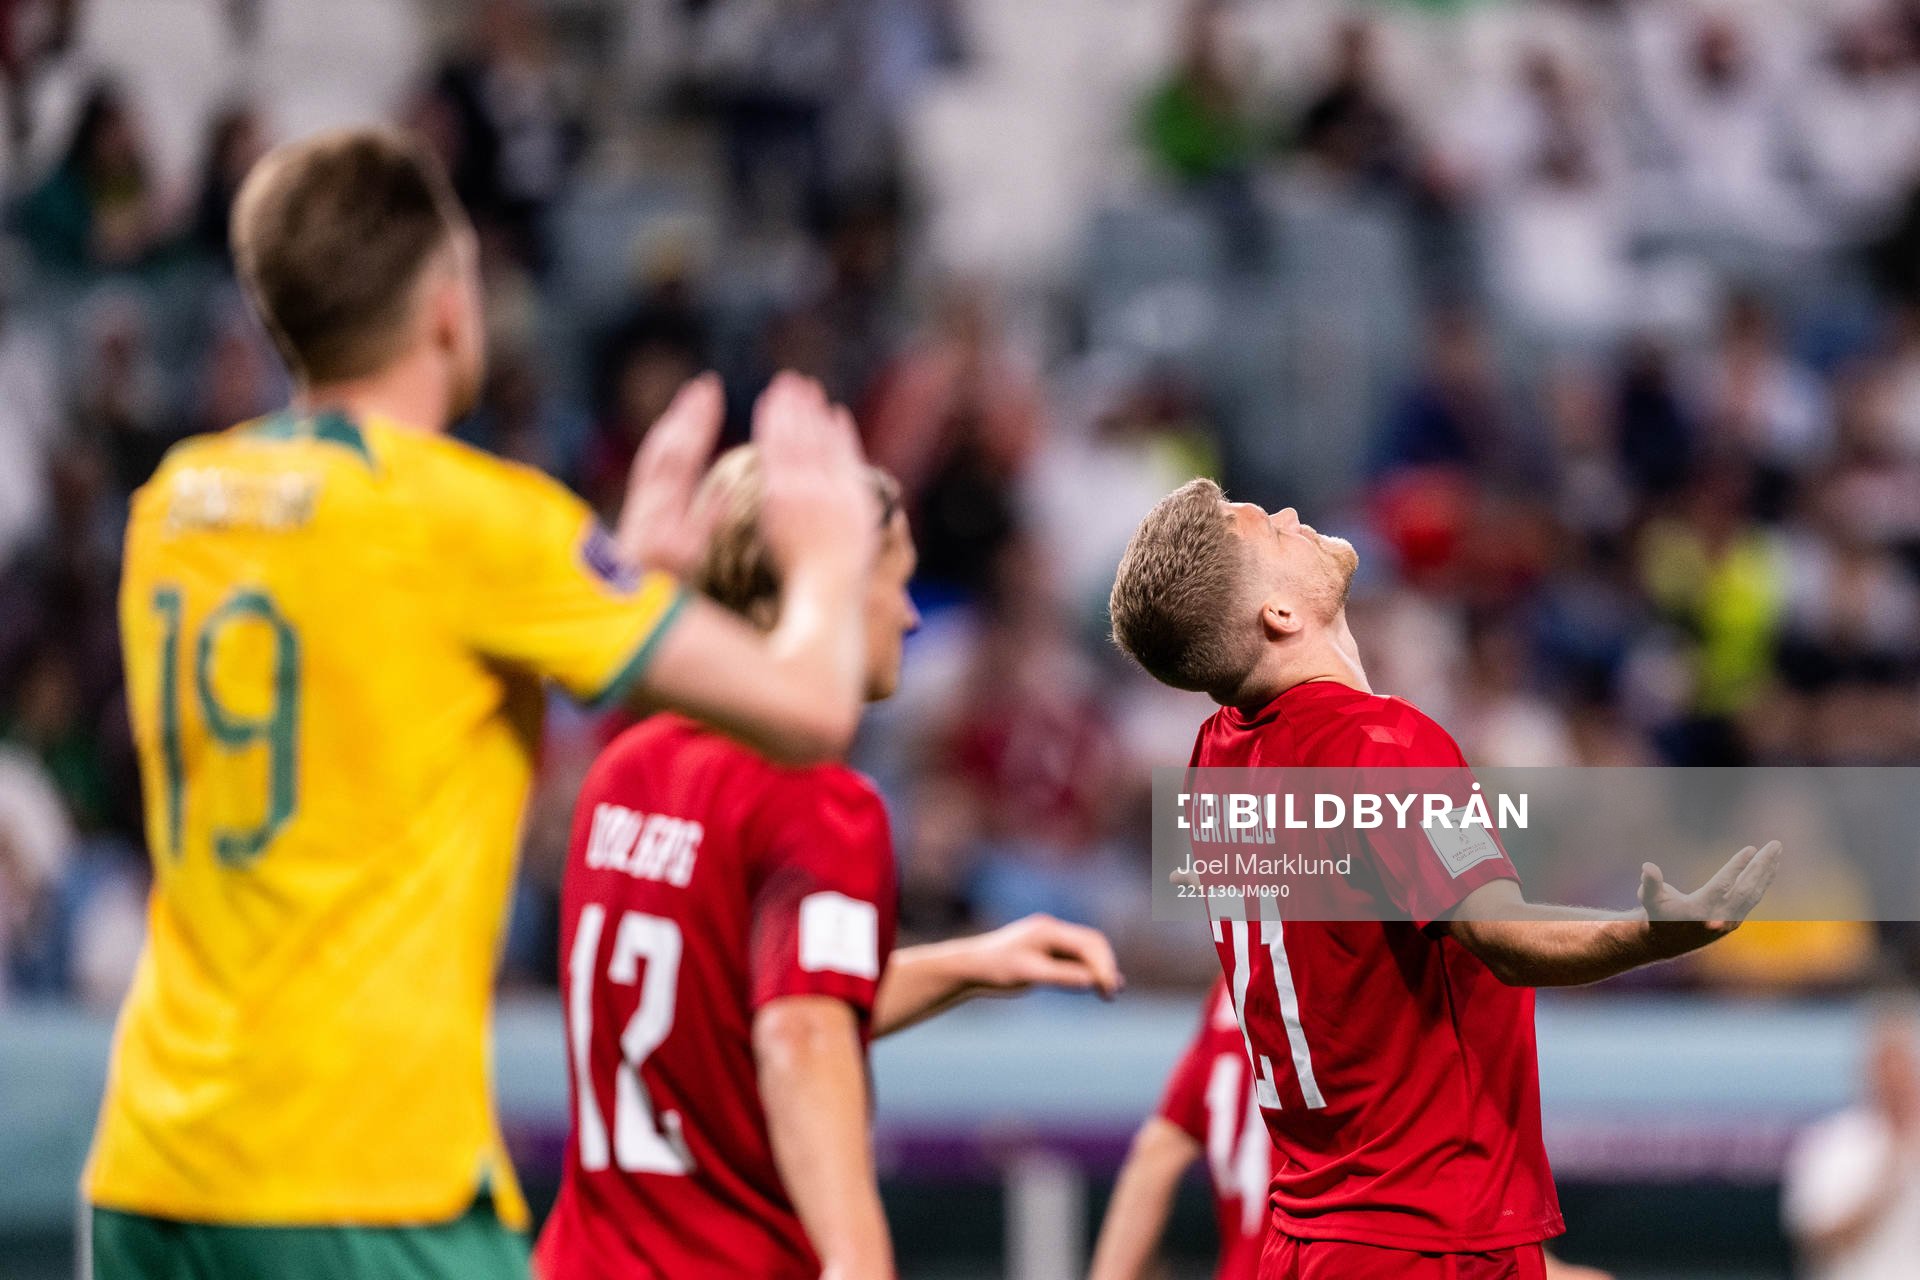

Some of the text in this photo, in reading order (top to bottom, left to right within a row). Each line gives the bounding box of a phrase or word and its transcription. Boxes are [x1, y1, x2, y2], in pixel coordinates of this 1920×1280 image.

[151, 585, 301, 866] 19
[1191, 792, 1276, 845] CORNEIUS
[570, 903, 697, 1174] 12
[1207, 888, 1328, 1110] 21
